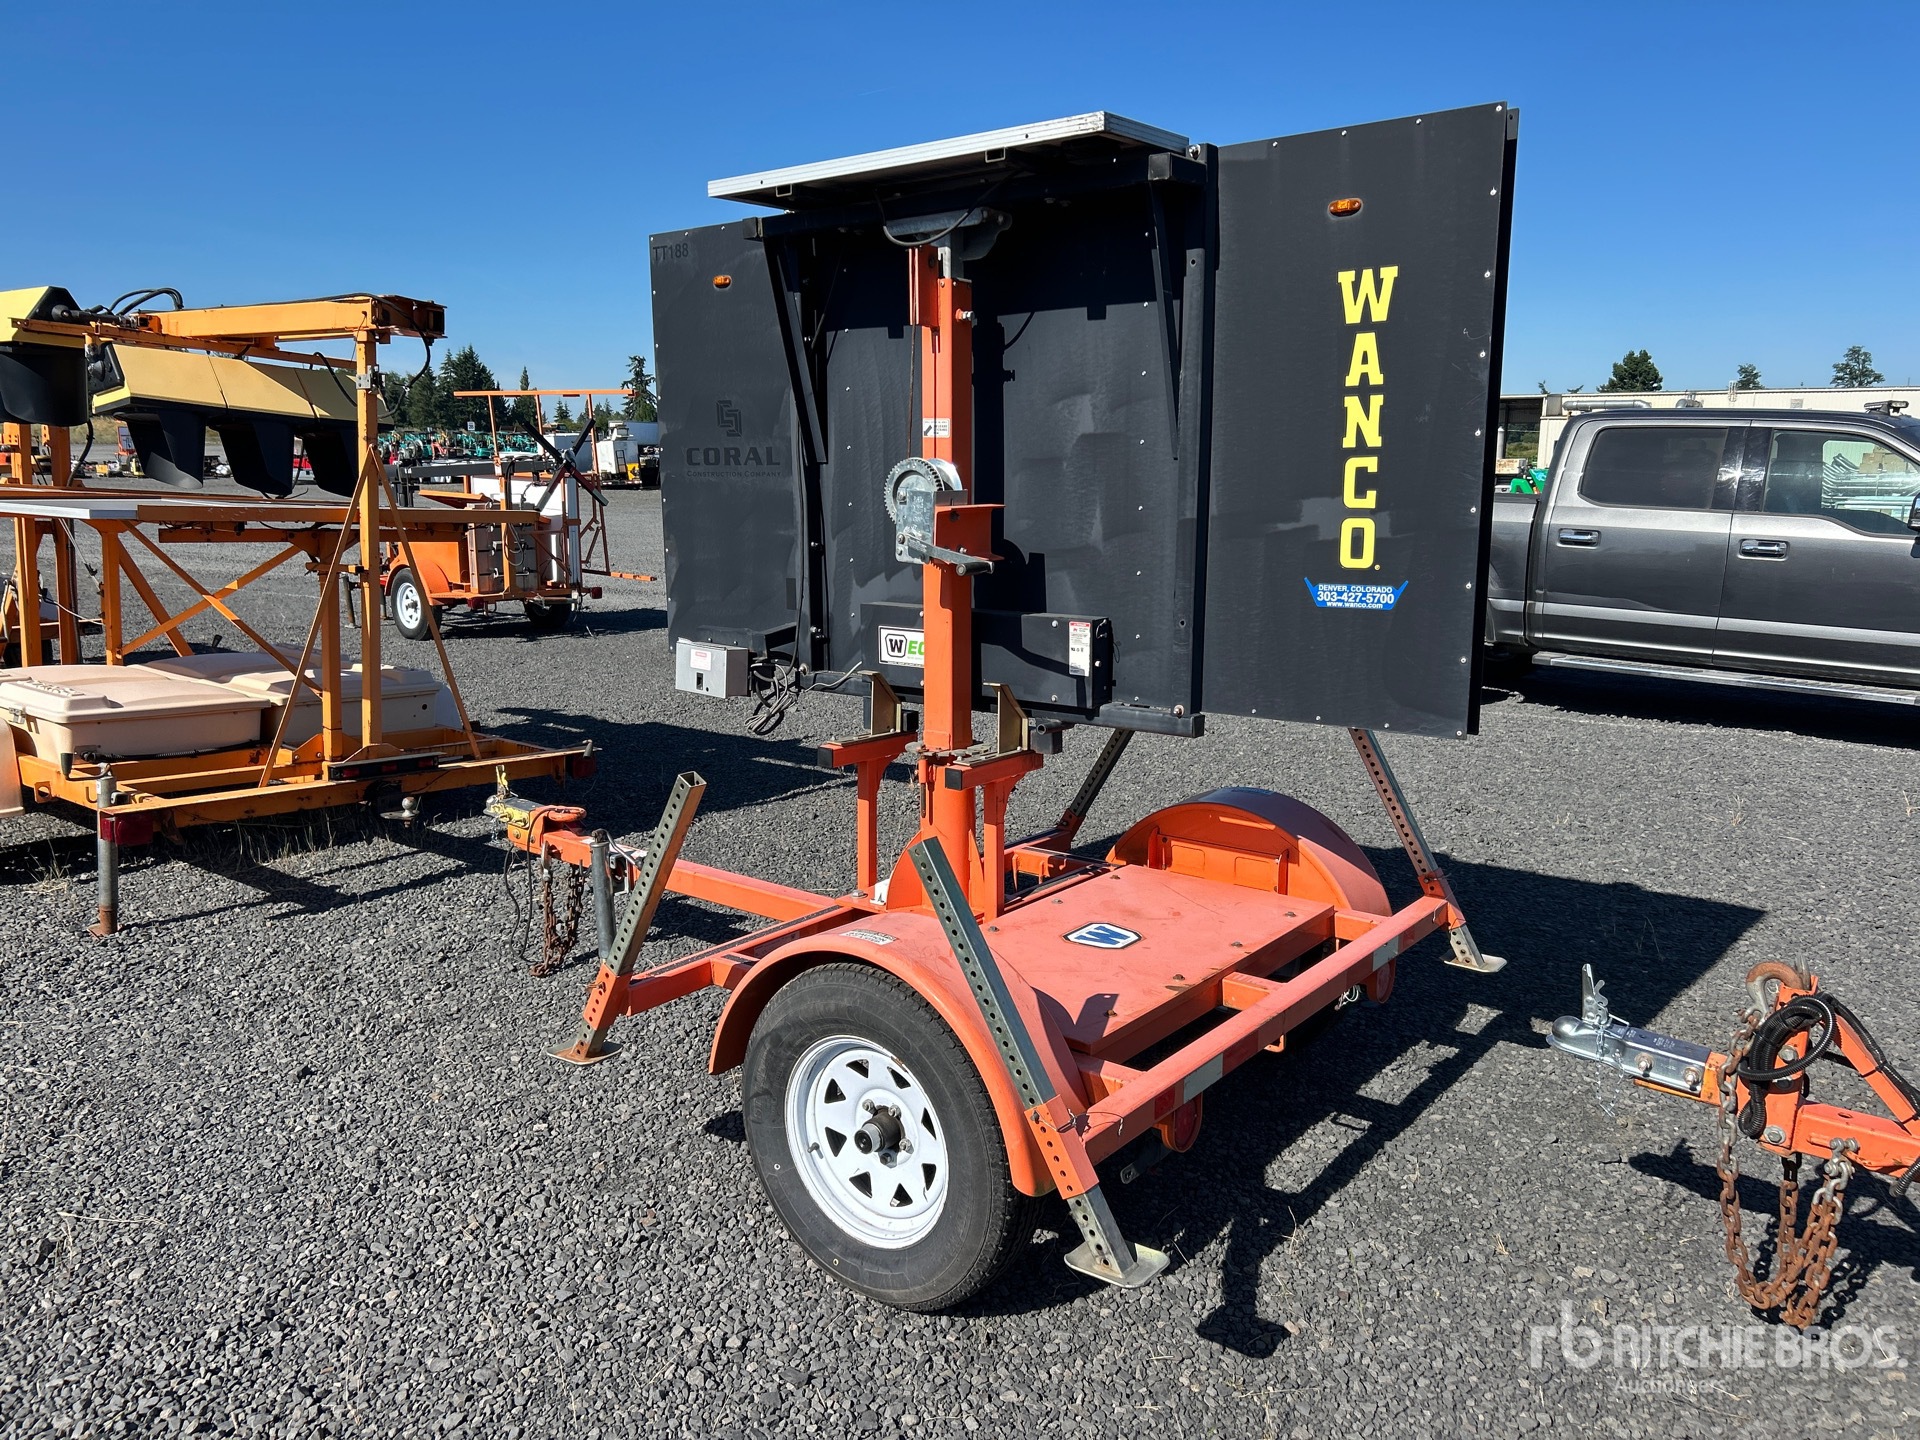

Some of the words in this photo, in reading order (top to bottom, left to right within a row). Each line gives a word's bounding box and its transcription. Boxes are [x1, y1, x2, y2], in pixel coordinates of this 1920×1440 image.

[652, 243, 690, 261] TT188
[686, 446, 781, 467] CORAL
[1318, 584, 1349, 593] DENVER,
[1350, 586, 1393, 594] COLORADO
[1317, 591, 1394, 604] 303-427-5700
[1326, 601, 1383, 609] www.wanco.com
